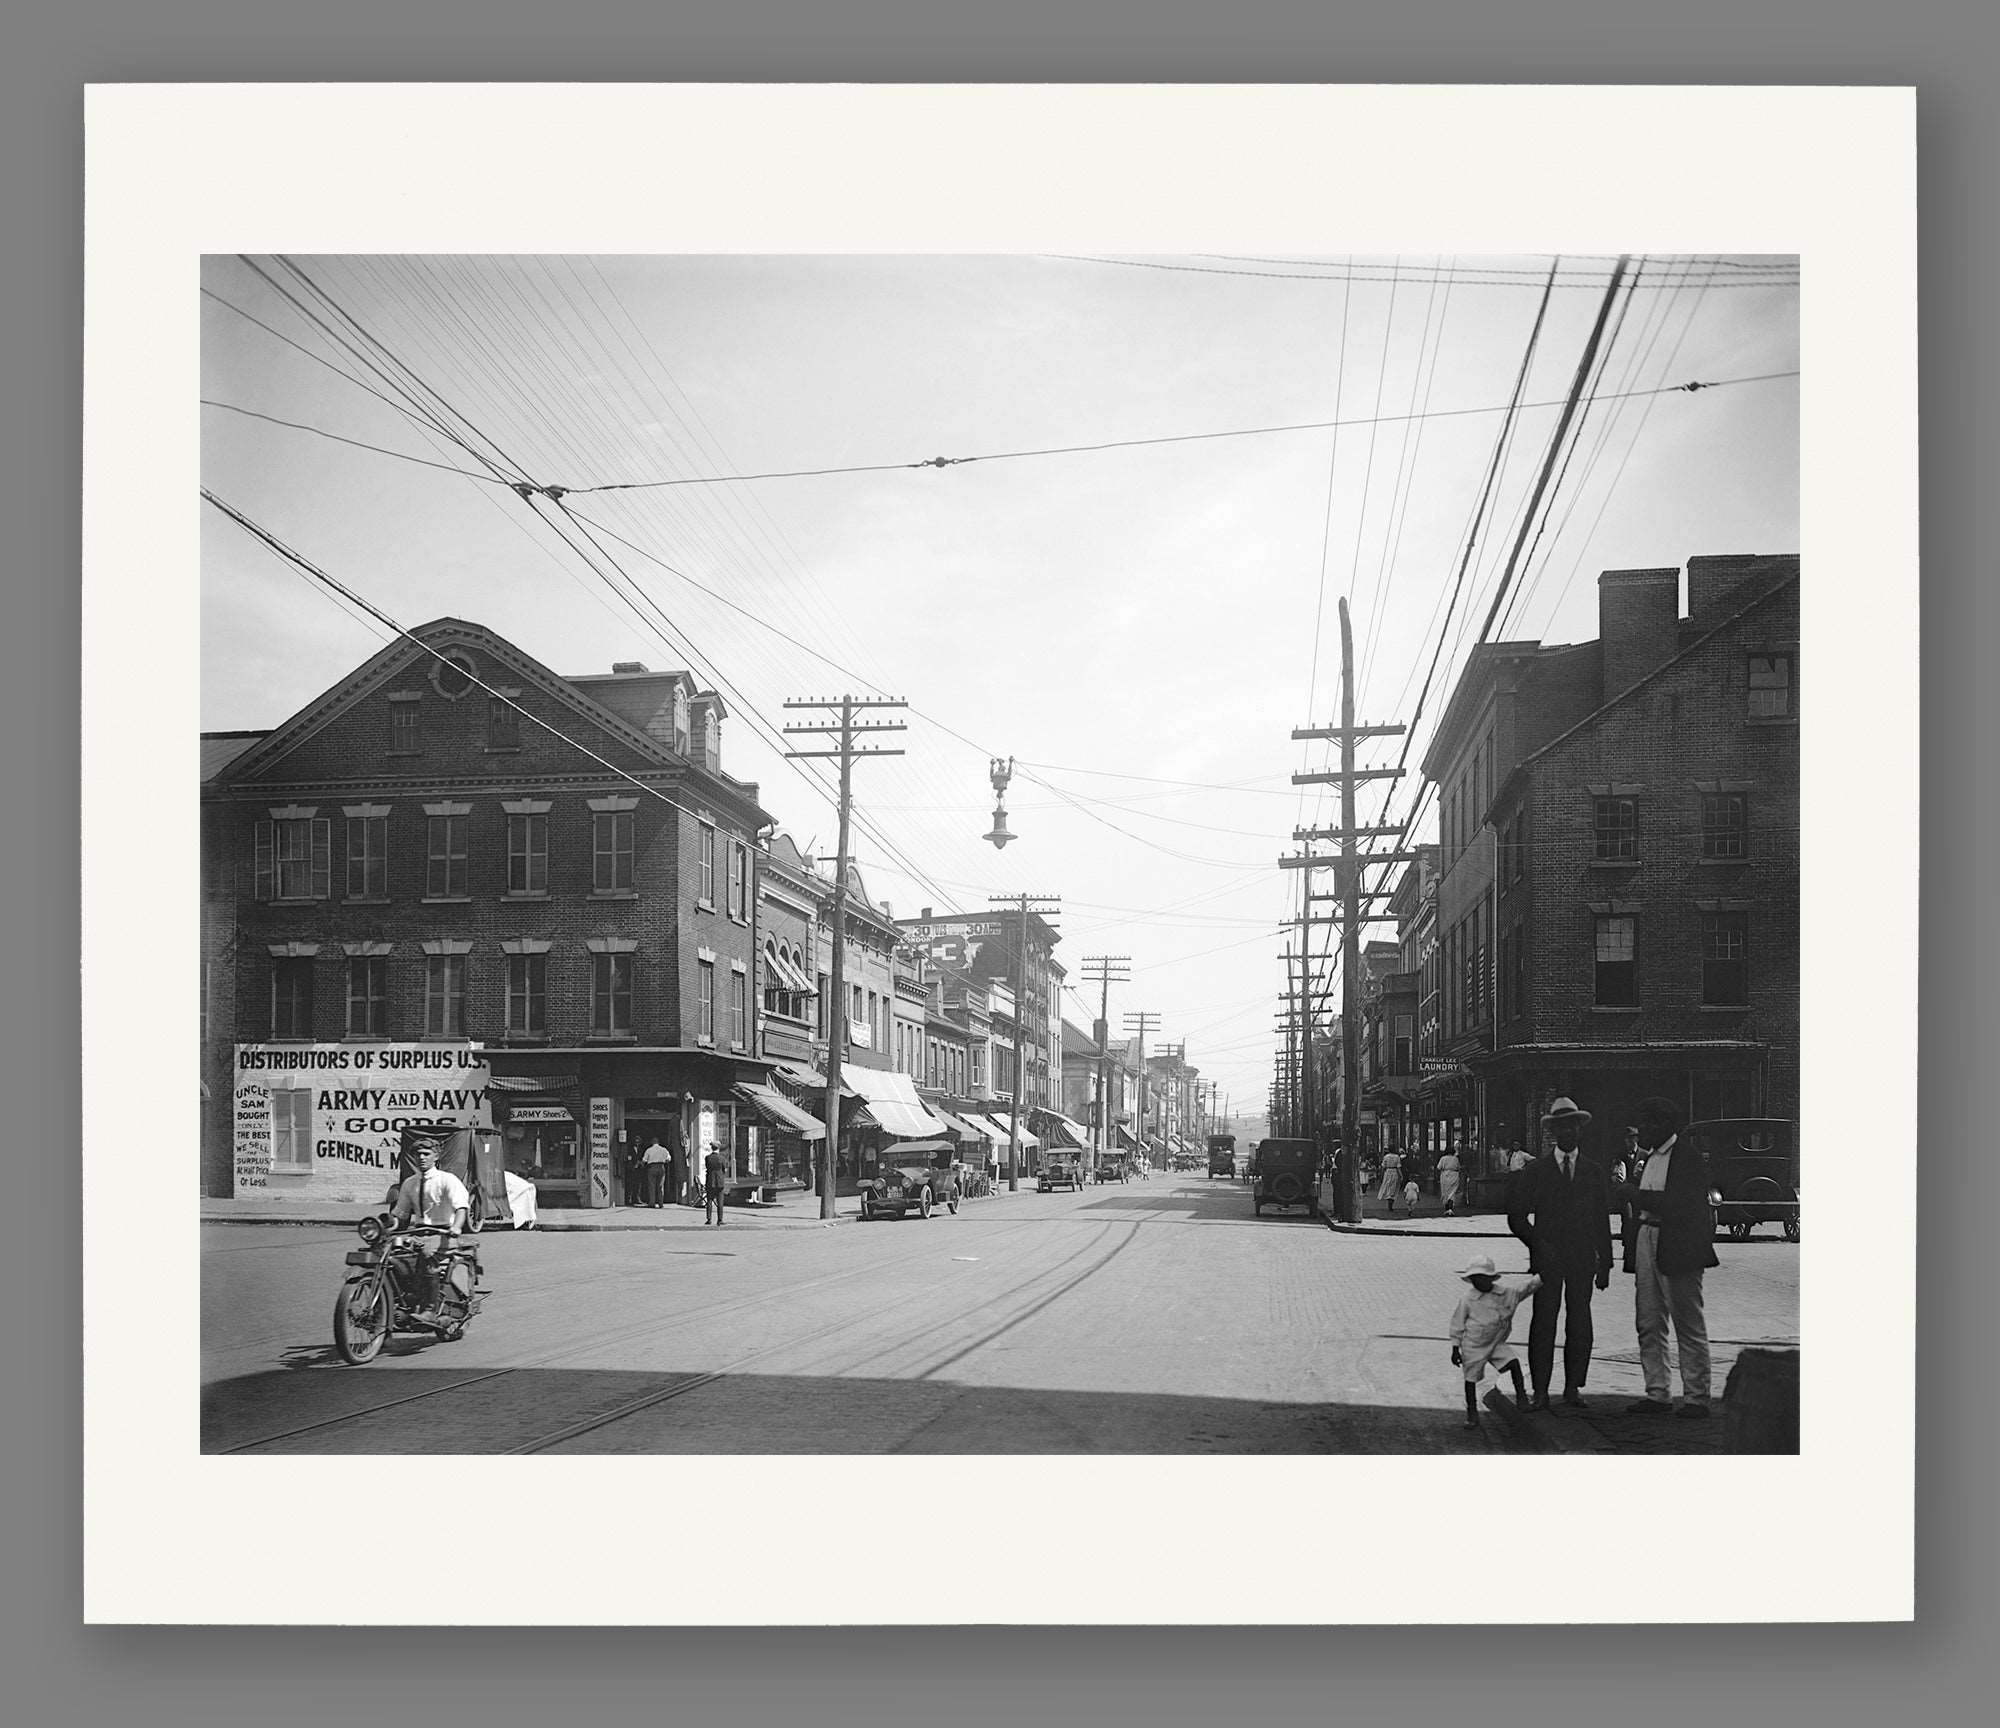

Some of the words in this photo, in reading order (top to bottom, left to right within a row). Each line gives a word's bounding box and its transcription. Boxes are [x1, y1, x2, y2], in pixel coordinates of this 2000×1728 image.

[239, 1050, 349, 1069] DISTRIBUTORS
[354, 1050, 375, 1069] OF
[379, 1050, 453, 1069] SURPLUS
[457, 1050, 487, 1069] U.S.
[1419, 1063, 1459, 1071] LAUNDRY
[236, 1084, 269, 1099] UNCLE
[317, 1089, 386, 1110] ARMY
[387, 1091, 419, 1108] AND
[422, 1089, 486, 1110] NAVY
[241, 1100, 265, 1109] SAM
[237, 1112, 270, 1120] BOUGHT
[237, 1131, 249, 1139] THE
[252, 1131, 270, 1139] BEST
[380, 1138, 401, 1147] AN
[316, 1140, 384, 1169] GENERAL
